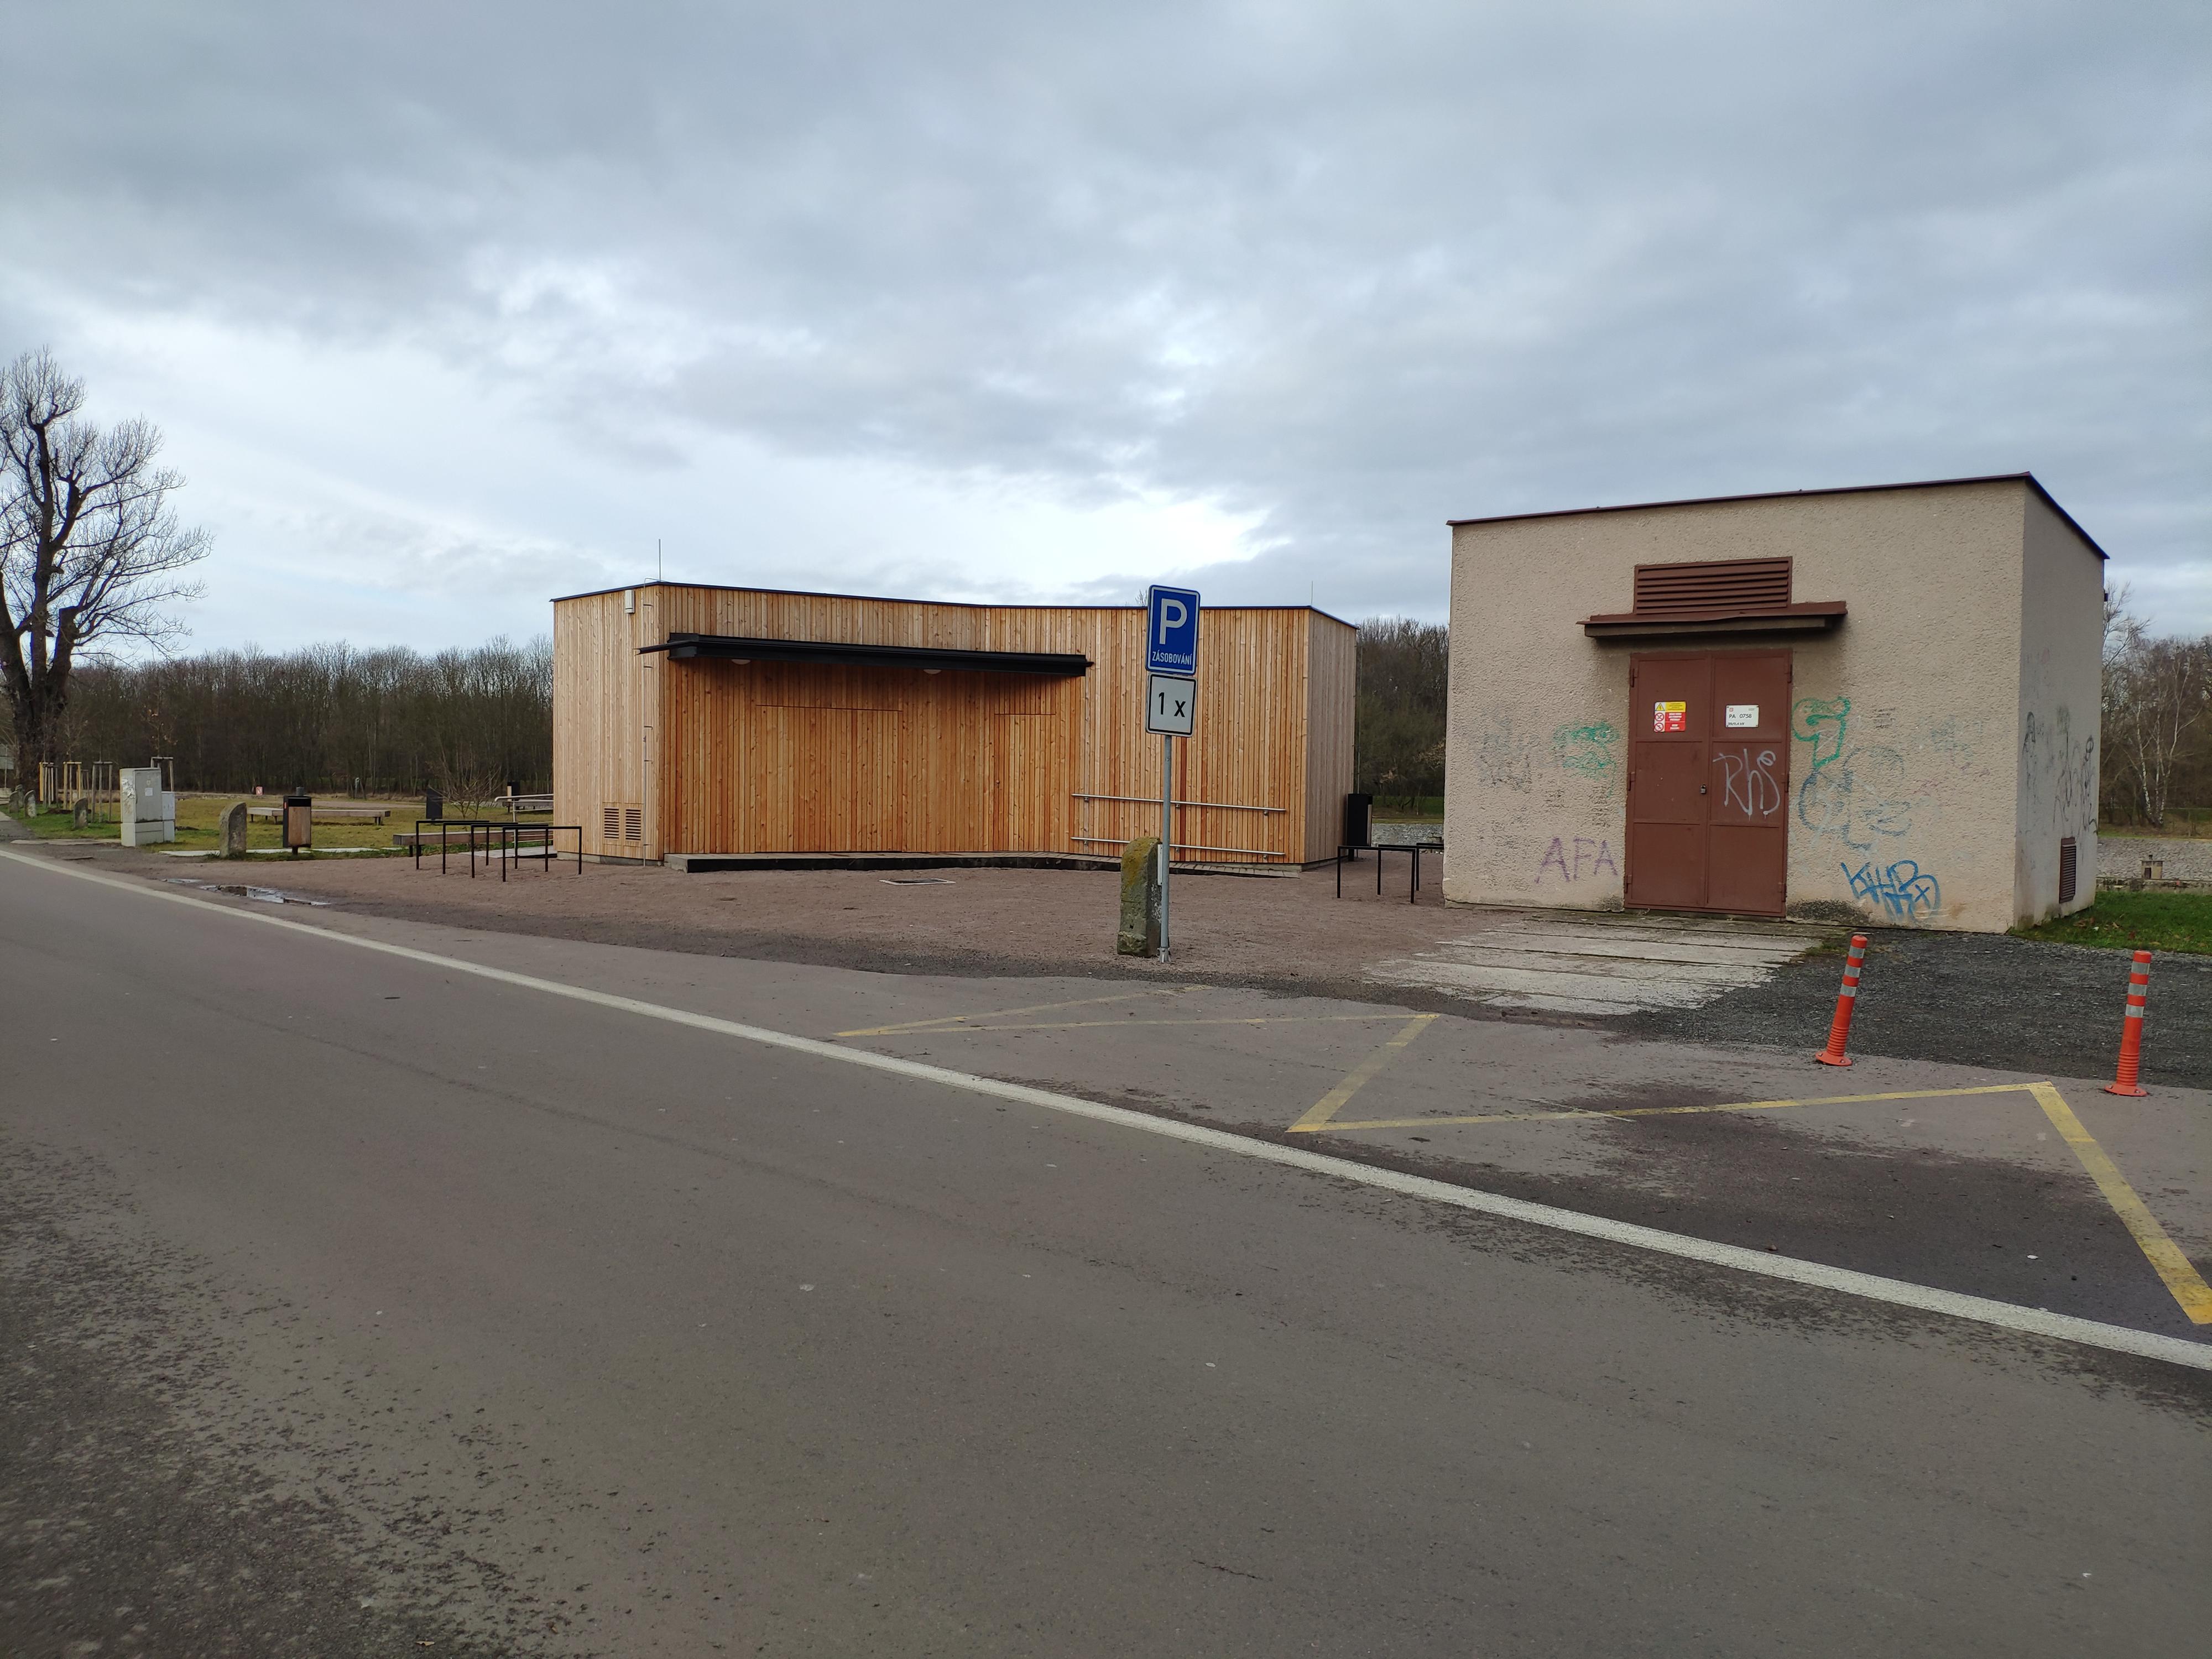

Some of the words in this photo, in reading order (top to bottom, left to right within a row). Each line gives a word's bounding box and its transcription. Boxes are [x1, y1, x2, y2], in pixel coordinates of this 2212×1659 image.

[1159, 598, 1187, 645] P
[1152, 649, 1192, 666] ZÁSOBOVÁNÍ
[1159, 692, 1165, 715] 1
